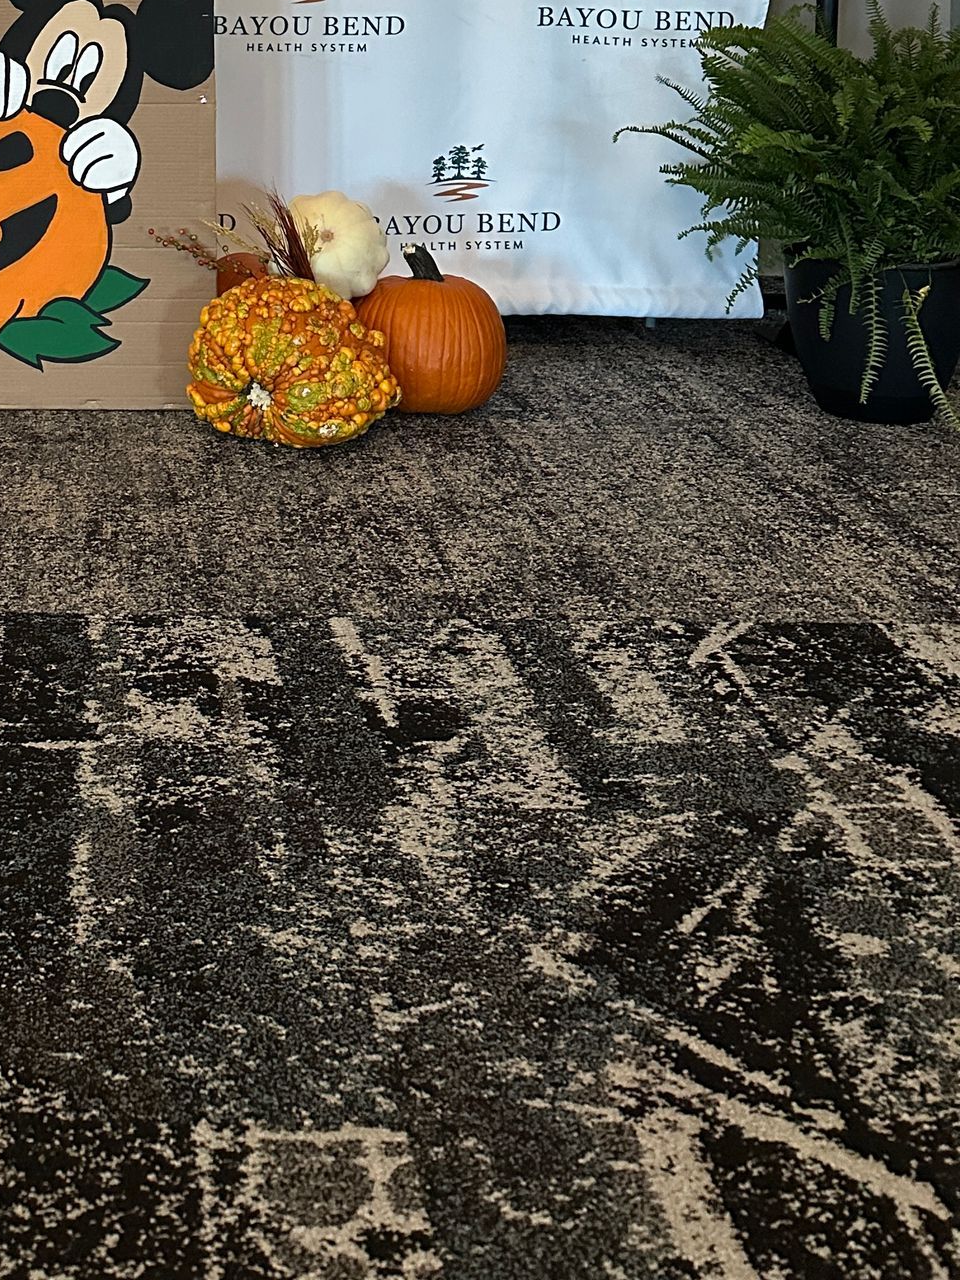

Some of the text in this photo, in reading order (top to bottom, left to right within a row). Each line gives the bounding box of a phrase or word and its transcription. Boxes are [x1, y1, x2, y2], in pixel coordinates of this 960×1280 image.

[214, 15, 405, 36] BAYOU BEND
[537, 7, 735, 31] BAYOU BEND
[247, 43, 367, 52] HEALTH SYSTEM
[572, 35, 702, 48] HEALTH SYSTEM
[373, 212, 561, 235] AYOU BEND
[400, 241, 524, 251] HALTH SYSTEM
